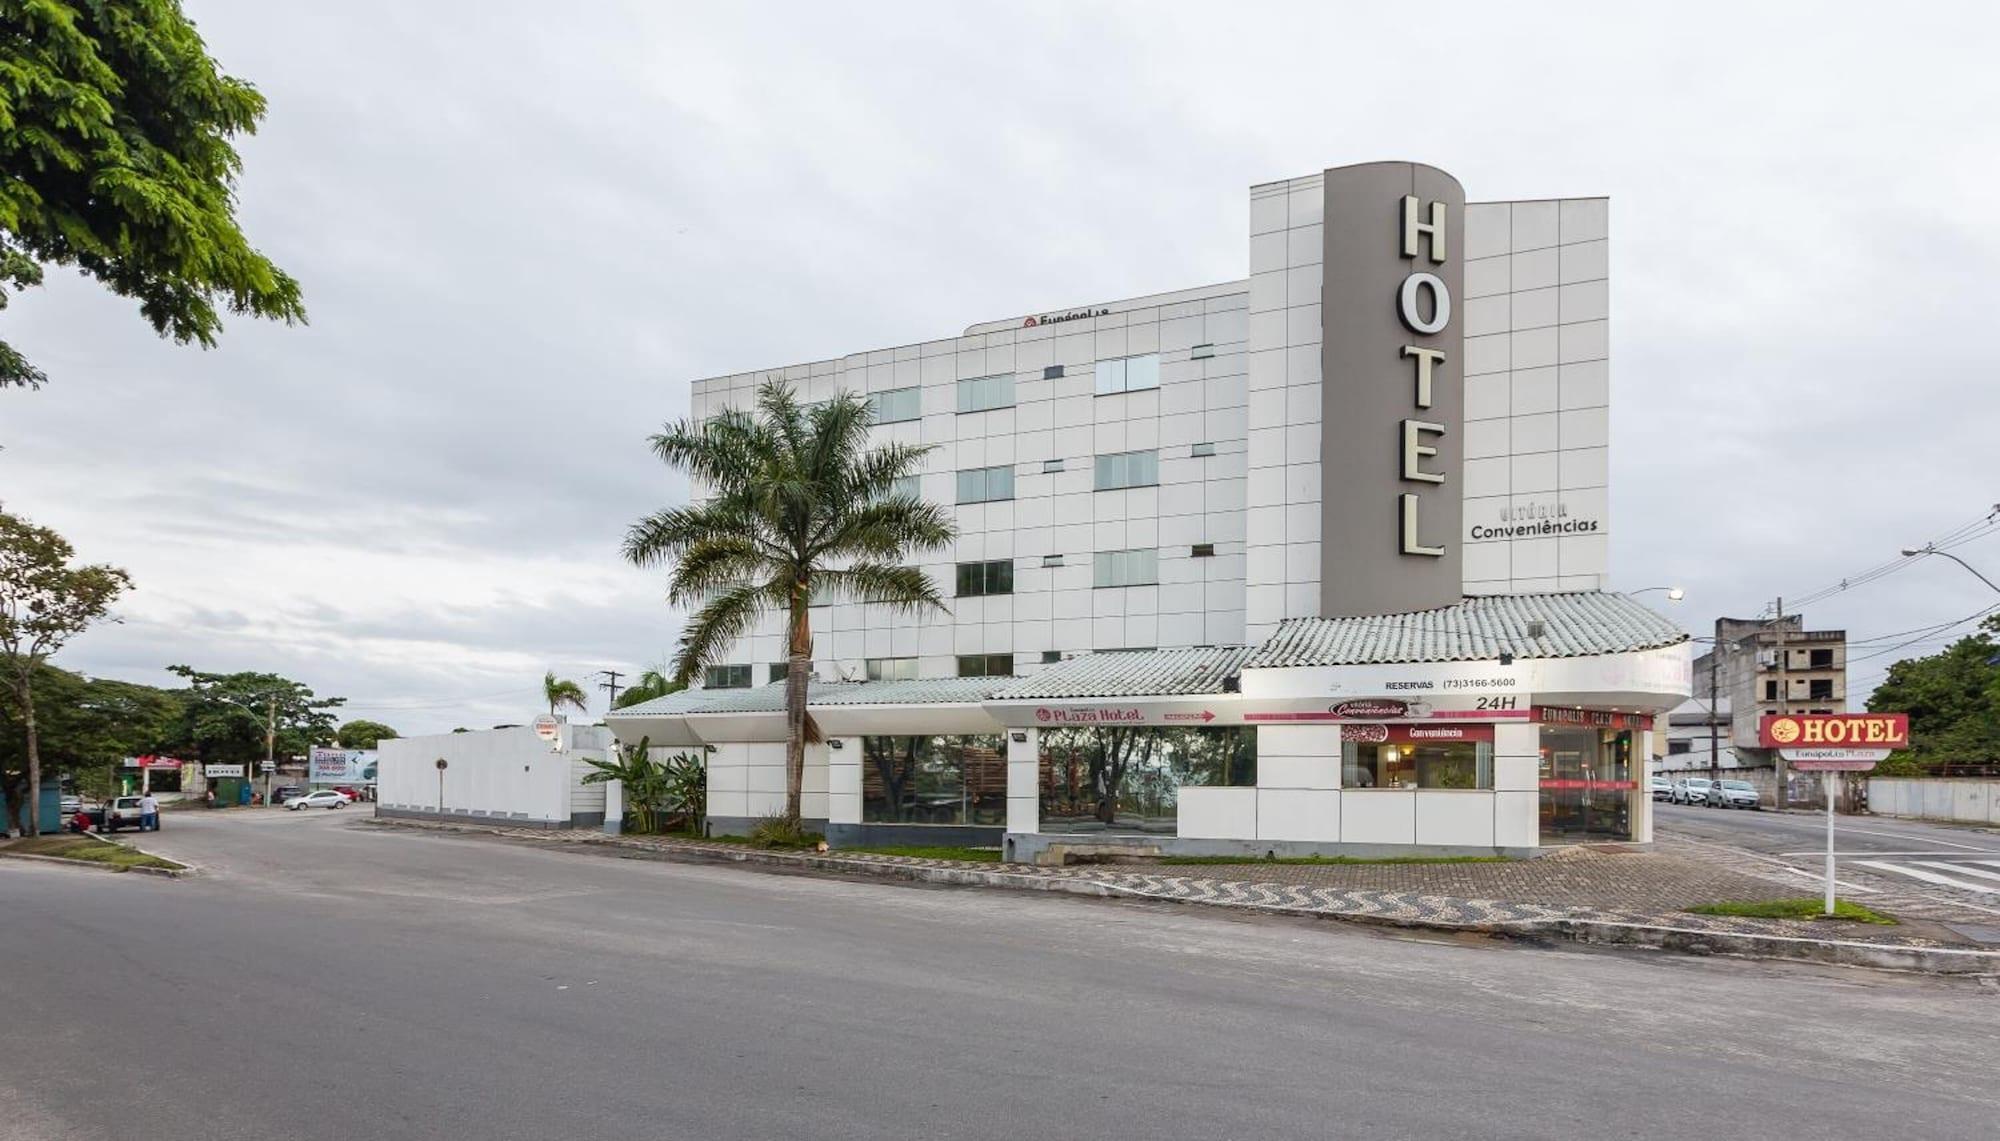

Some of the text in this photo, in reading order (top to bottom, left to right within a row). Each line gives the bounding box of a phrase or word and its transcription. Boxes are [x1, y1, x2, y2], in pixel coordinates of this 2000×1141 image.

[1397, 194, 1451, 556] HOTEL
[1471, 519, 1598, 540] Conveniências
[1385, 678, 1516, 690] RESERVAS (73)3166-5600
[1476, 696, 1517, 710] 24H
[1803, 719, 1903, 743] HOTEL
